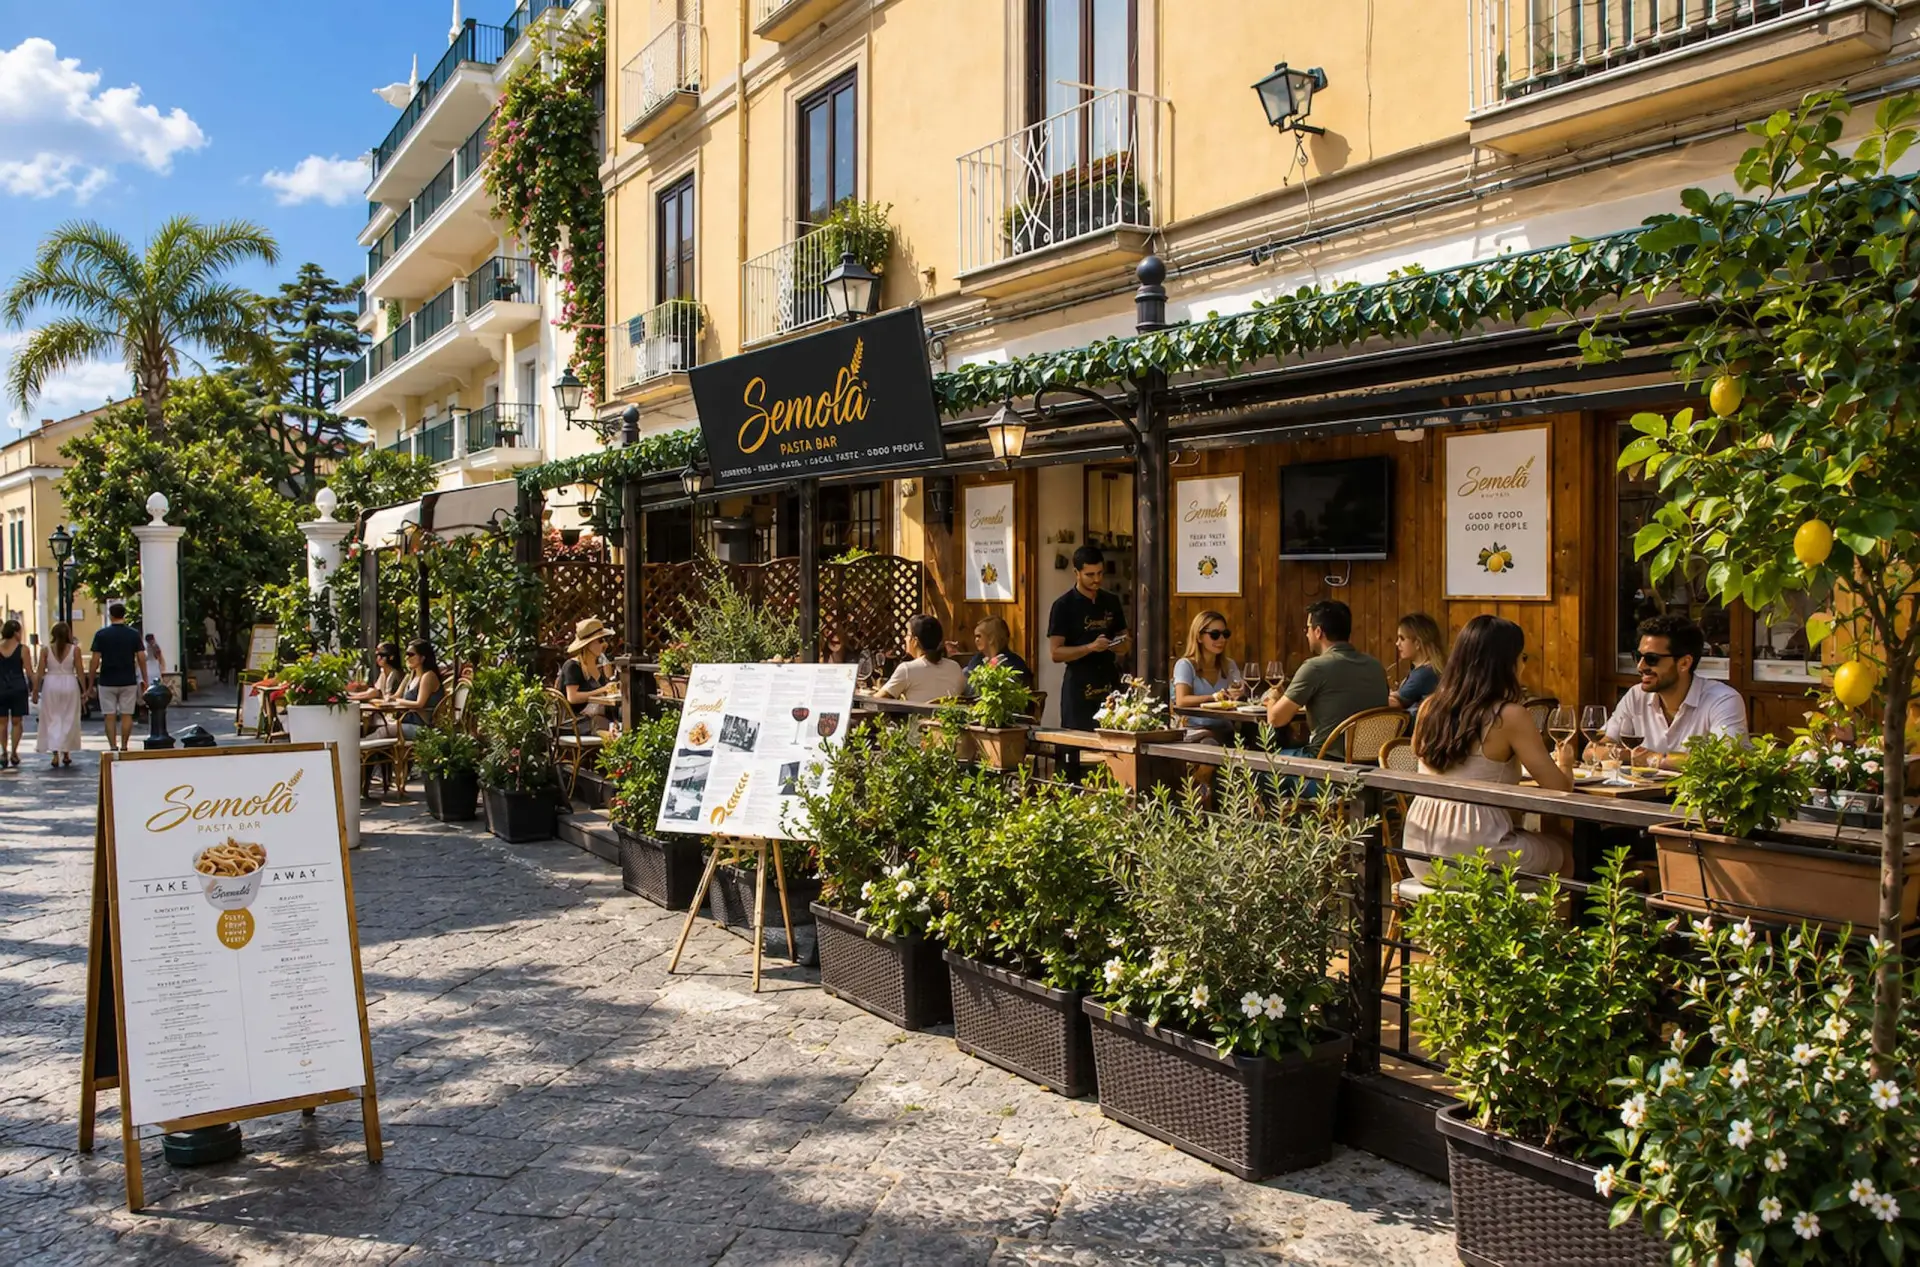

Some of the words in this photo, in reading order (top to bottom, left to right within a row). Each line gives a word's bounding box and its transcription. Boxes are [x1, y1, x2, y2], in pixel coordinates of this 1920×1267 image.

[780, 439, 813, 456] PASTA
[815, 435, 838, 450] BAR
[1468, 511, 1493, 521] GOOD
[1465, 523, 1490, 532] GOOD
[1494, 521, 1528, 531] PEOPLE
[198, 823, 233, 834] PASTA
[239, 821, 261, 831] BAR
[144, 880, 188, 894] TAKE
[273, 868, 316, 881] AWAY
